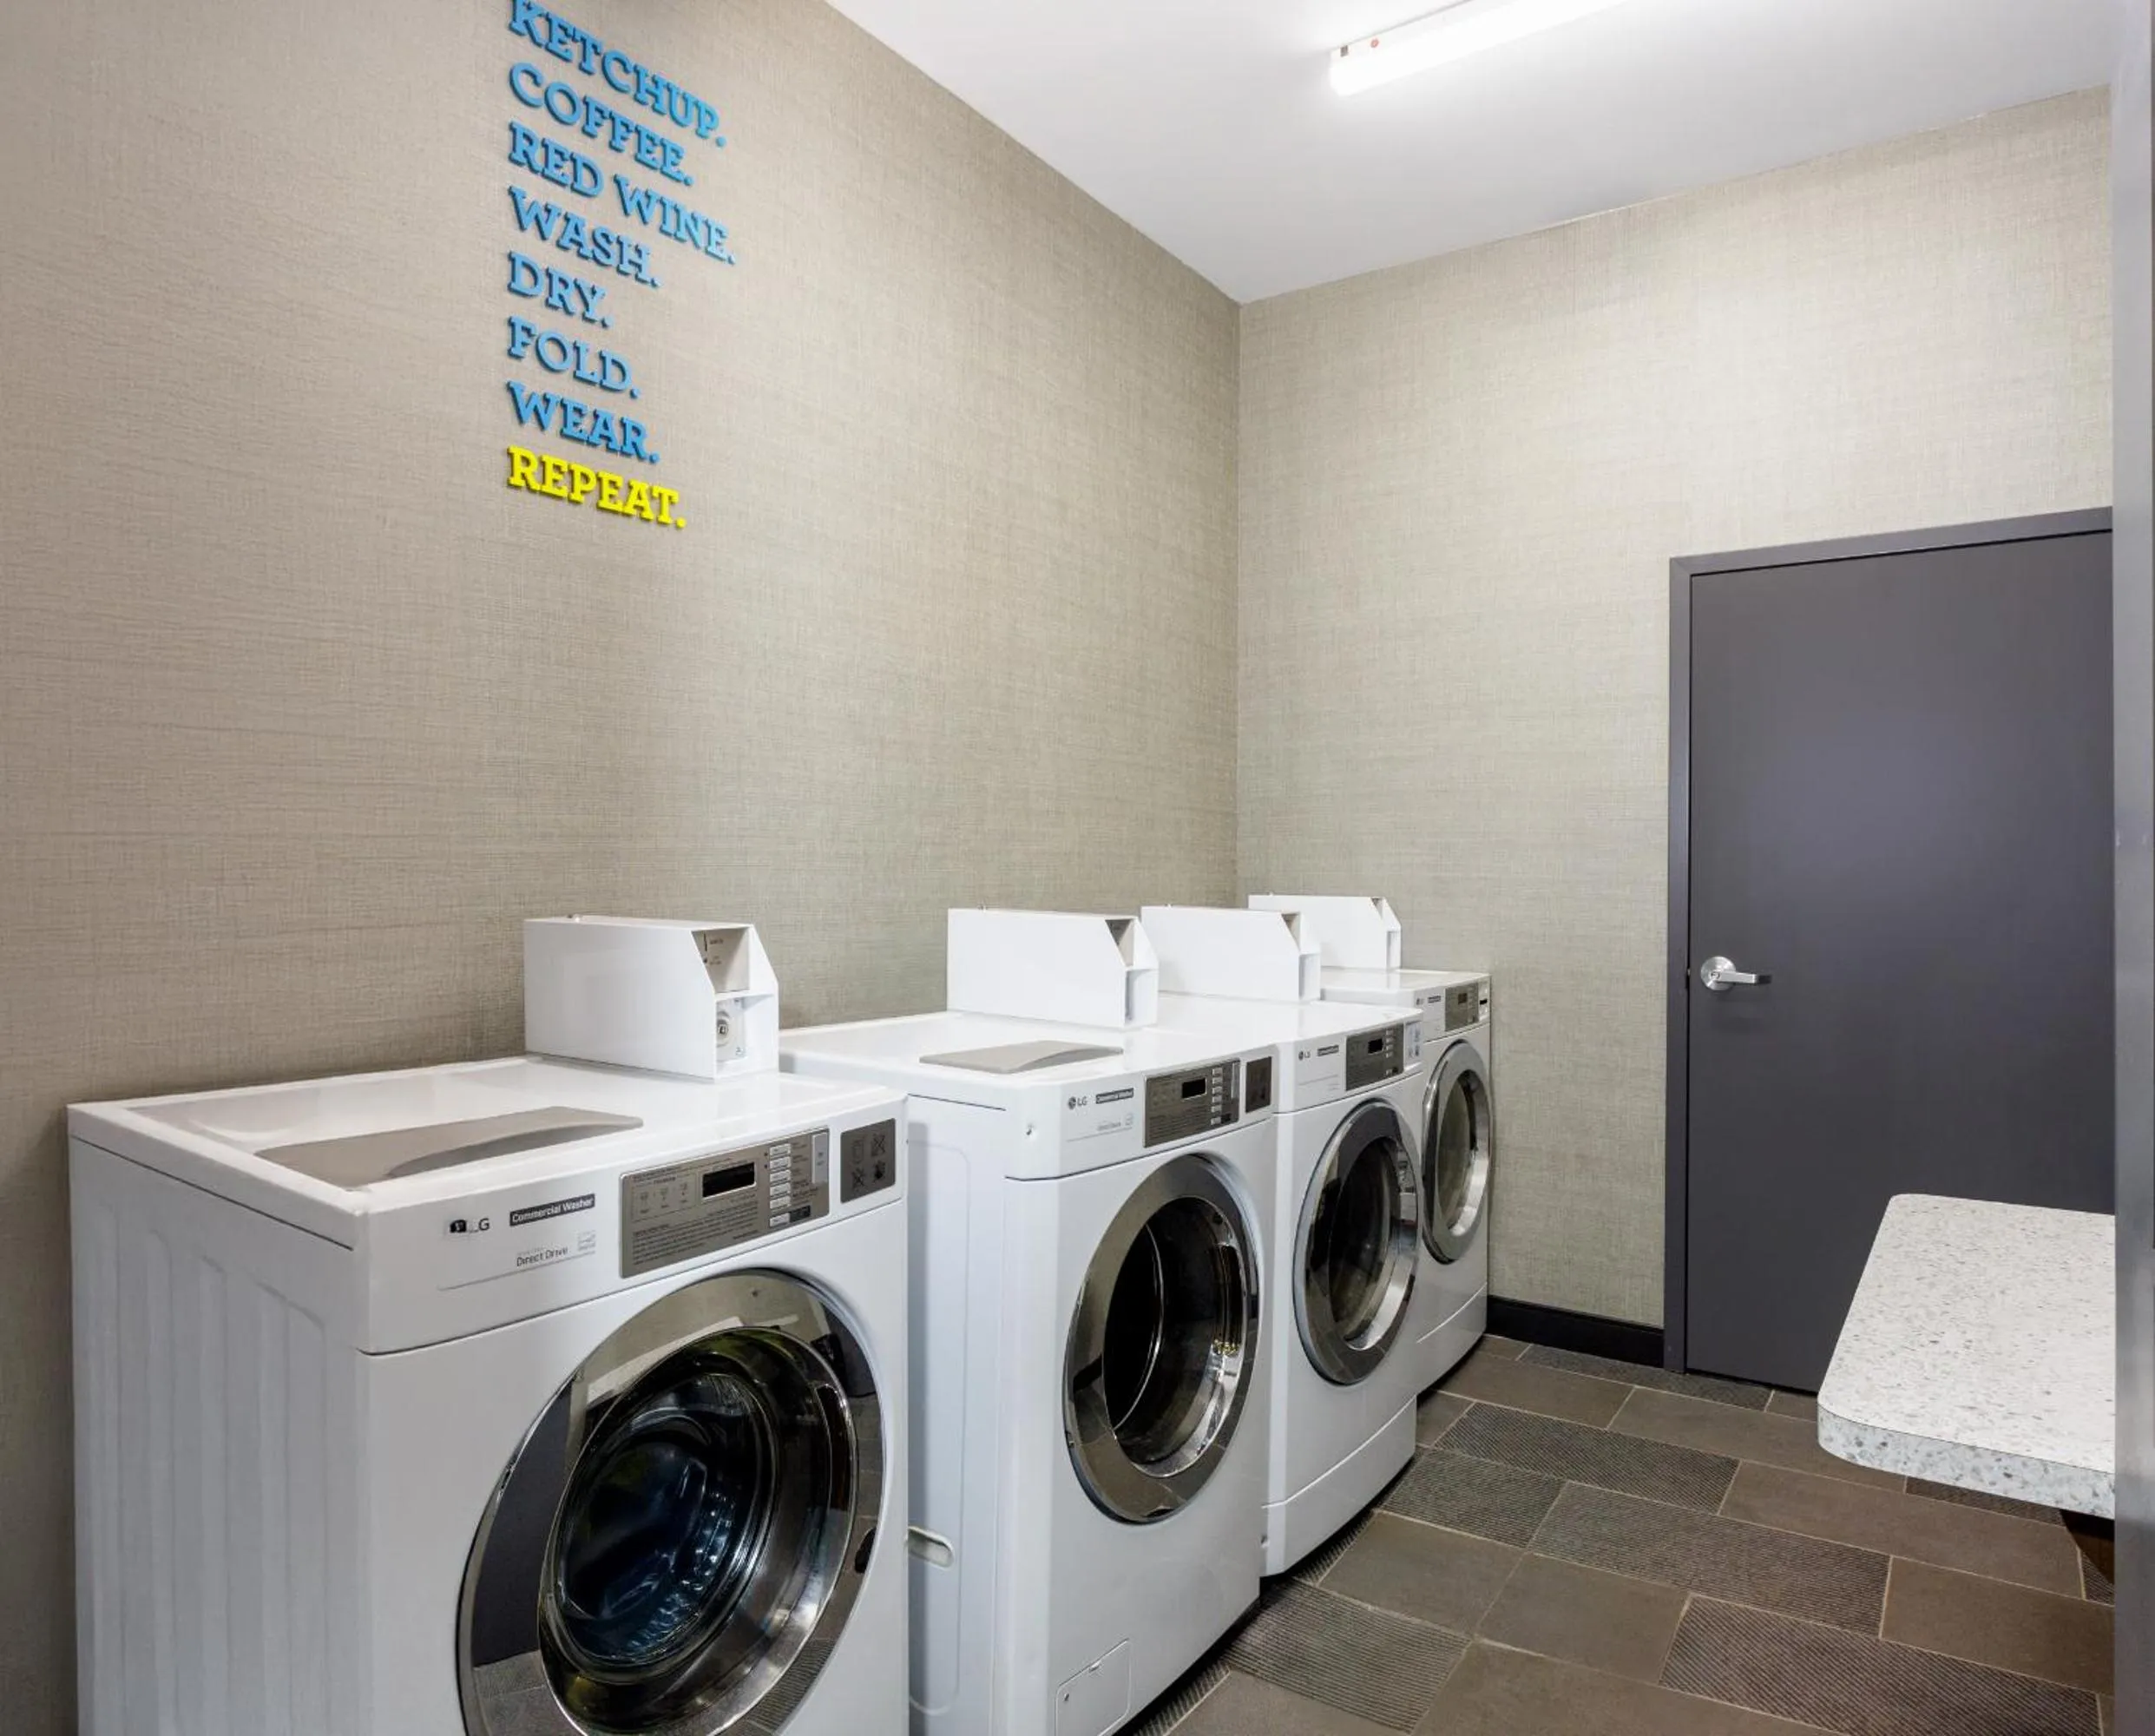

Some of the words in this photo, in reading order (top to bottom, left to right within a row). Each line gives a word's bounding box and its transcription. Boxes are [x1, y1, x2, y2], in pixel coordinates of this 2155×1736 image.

[509, 0, 727, 148] KETCHUP.
[509, 62, 694, 187] COFFEE.
[508, 121, 605, 198] RED
[613, 174, 736, 265] WINE.
[508, 185, 663, 288] WASH.
[507, 250, 614, 328] DRY.
[507, 316, 641, 399] FOLD.
[506, 380, 660, 464] WEAR.
[507, 445, 687, 529] REPEAT.
[1077, 1095, 1087, 1106] LG
[512, 1205, 561, 1222] Commercial
[562, 1199, 594, 1212] Washer
[516, 1253, 543, 1266] Direct
